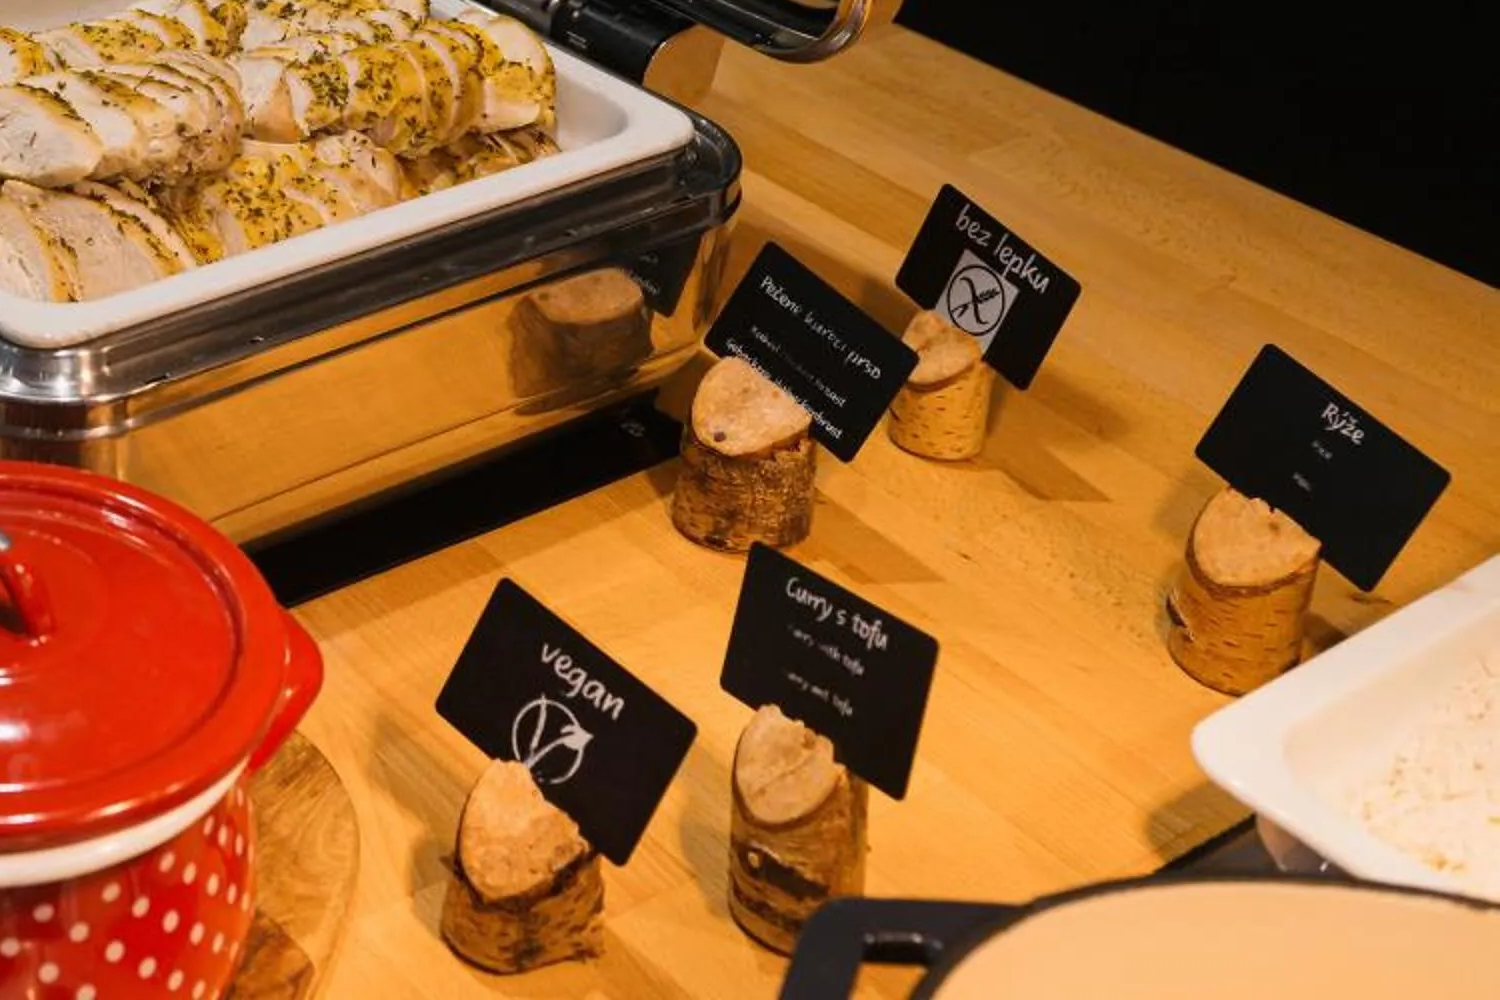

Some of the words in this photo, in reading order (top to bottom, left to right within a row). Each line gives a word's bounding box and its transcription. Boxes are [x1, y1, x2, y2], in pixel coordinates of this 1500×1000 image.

[956, 203, 992, 247] bez
[994, 232, 1050, 295] lepku
[1321, 402, 1365, 444] Rýže
[786, 577, 833, 622] Curry
[836, 609, 848, 625] s
[852, 613, 888, 651] tofu
[541, 643, 625, 720] vegan
